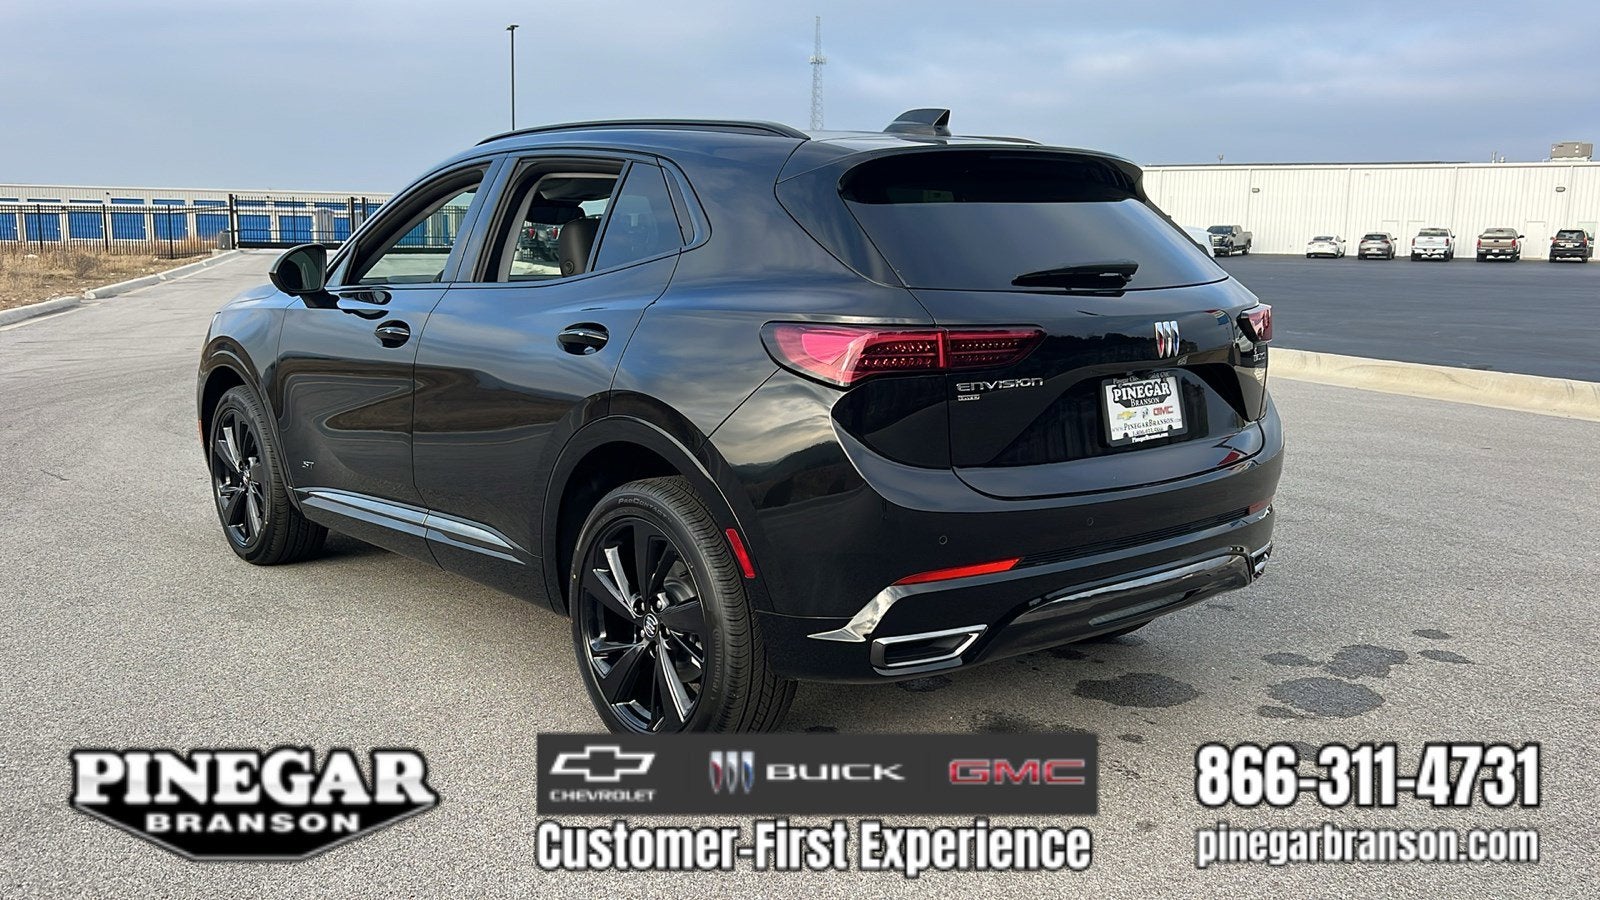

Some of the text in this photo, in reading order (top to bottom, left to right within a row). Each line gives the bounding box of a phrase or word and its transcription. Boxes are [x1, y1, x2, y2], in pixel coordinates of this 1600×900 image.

[956, 377, 1044, 391] ENVISION
[1112, 382, 1171, 402] PINEGAR
[1130, 397, 1160, 407] BRANSON
[1153, 405, 1174, 416] GMC
